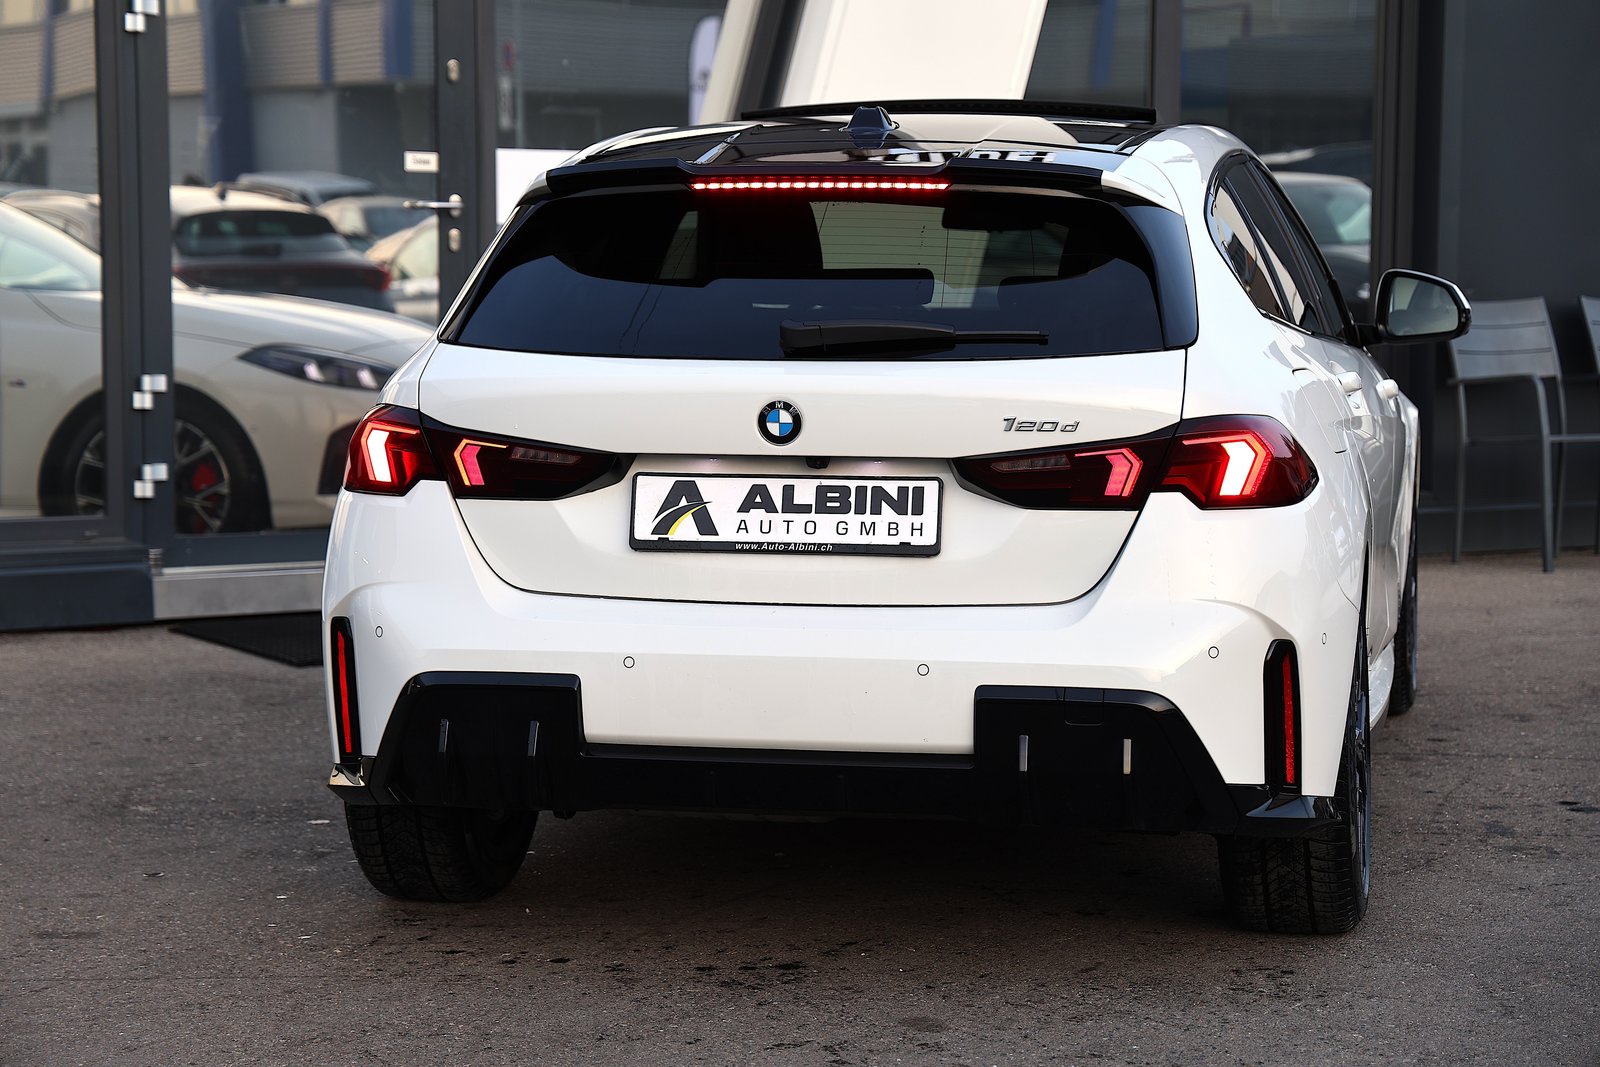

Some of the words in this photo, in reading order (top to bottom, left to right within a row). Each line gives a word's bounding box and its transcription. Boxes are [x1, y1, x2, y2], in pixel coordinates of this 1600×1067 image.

[762, 401, 799, 416] BMW
[1003, 416, 1080, 432] 120d
[737, 484, 925, 515] ALBINI
[736, 520, 817, 535] AUTO
[836, 521, 924, 537] GMBH
[735, 542, 833, 552] www.Auto-Albini.ch
